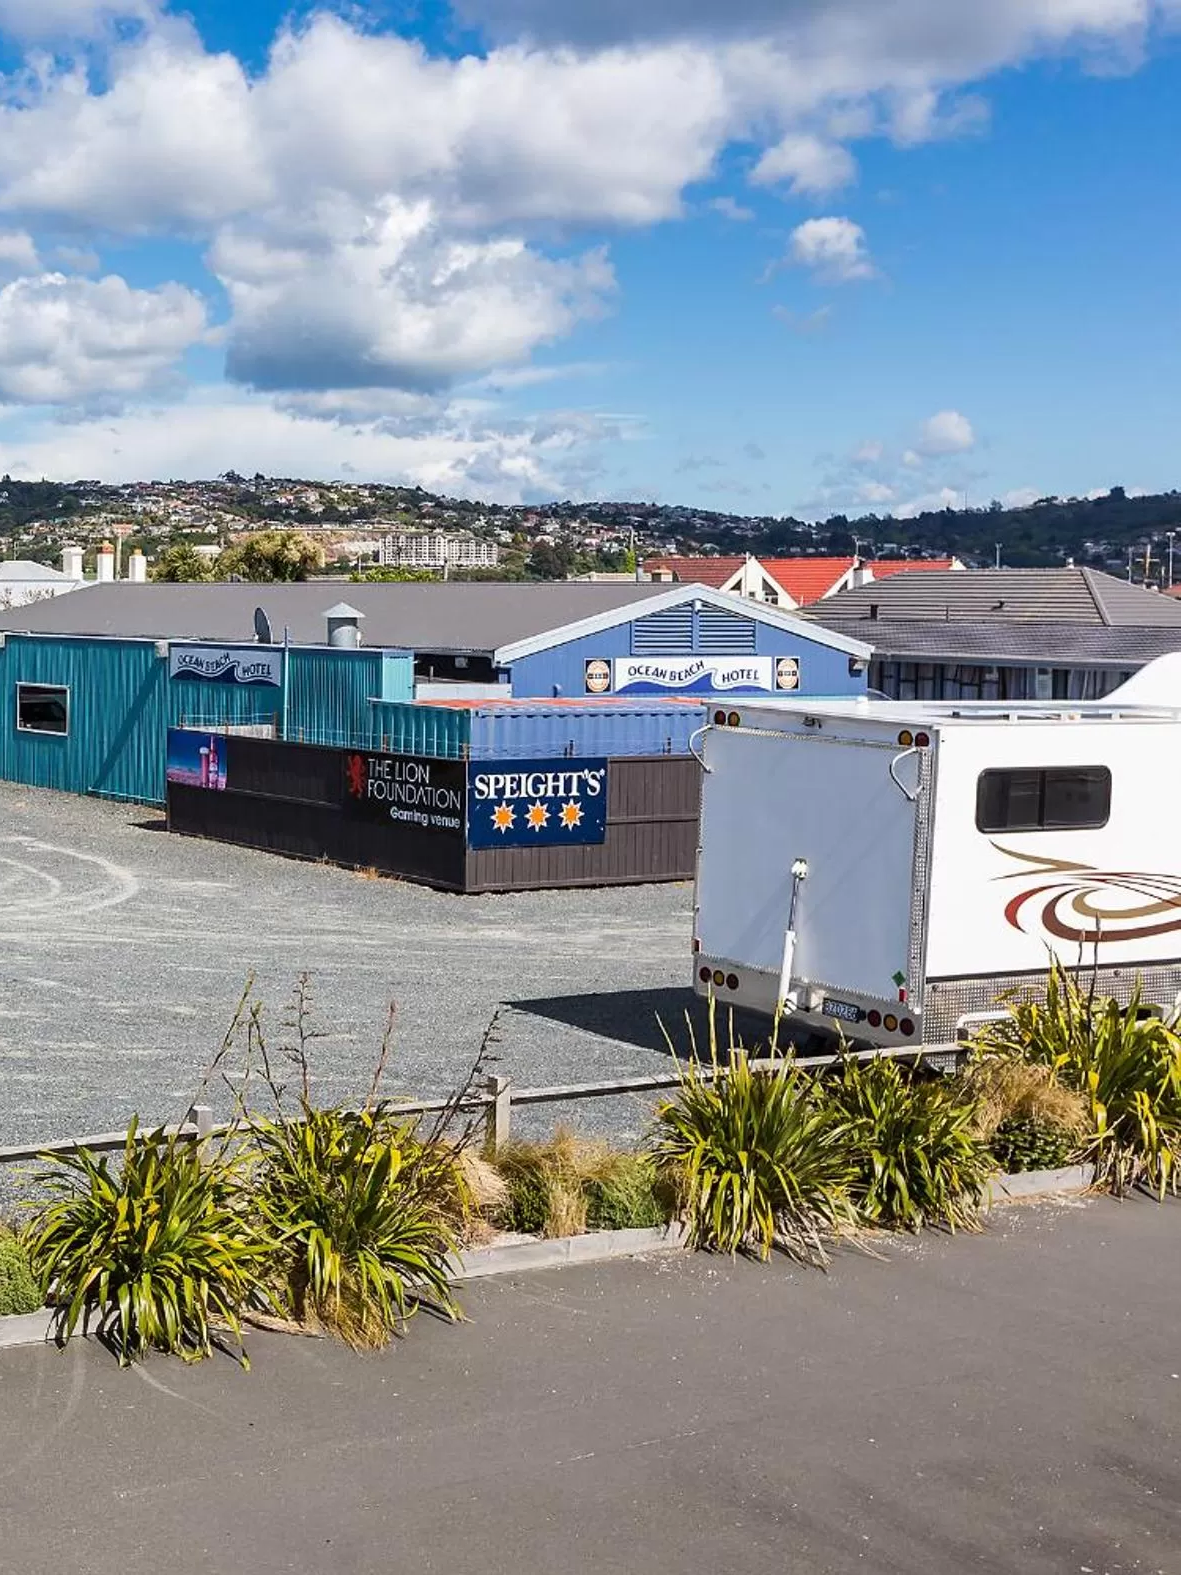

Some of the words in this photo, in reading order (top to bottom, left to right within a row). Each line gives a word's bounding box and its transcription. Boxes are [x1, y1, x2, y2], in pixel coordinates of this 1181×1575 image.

[177, 655, 204, 669] OCEAN
[205, 652, 231, 671] BEACH
[242, 663, 272, 676] HOTEL
[627, 665, 667, 679] OCEAN
[669, 660, 705, 681] BEACH
[722, 668, 760, 683] HOTEL
[368, 758, 393, 779] THE
[395, 761, 430, 784] LION
[474, 768, 601, 799] SPEIGHT'S
[367, 779, 461, 811] FOUNDATION
[390, 806, 429, 827] Gaming
[430, 814, 461, 829] venue
